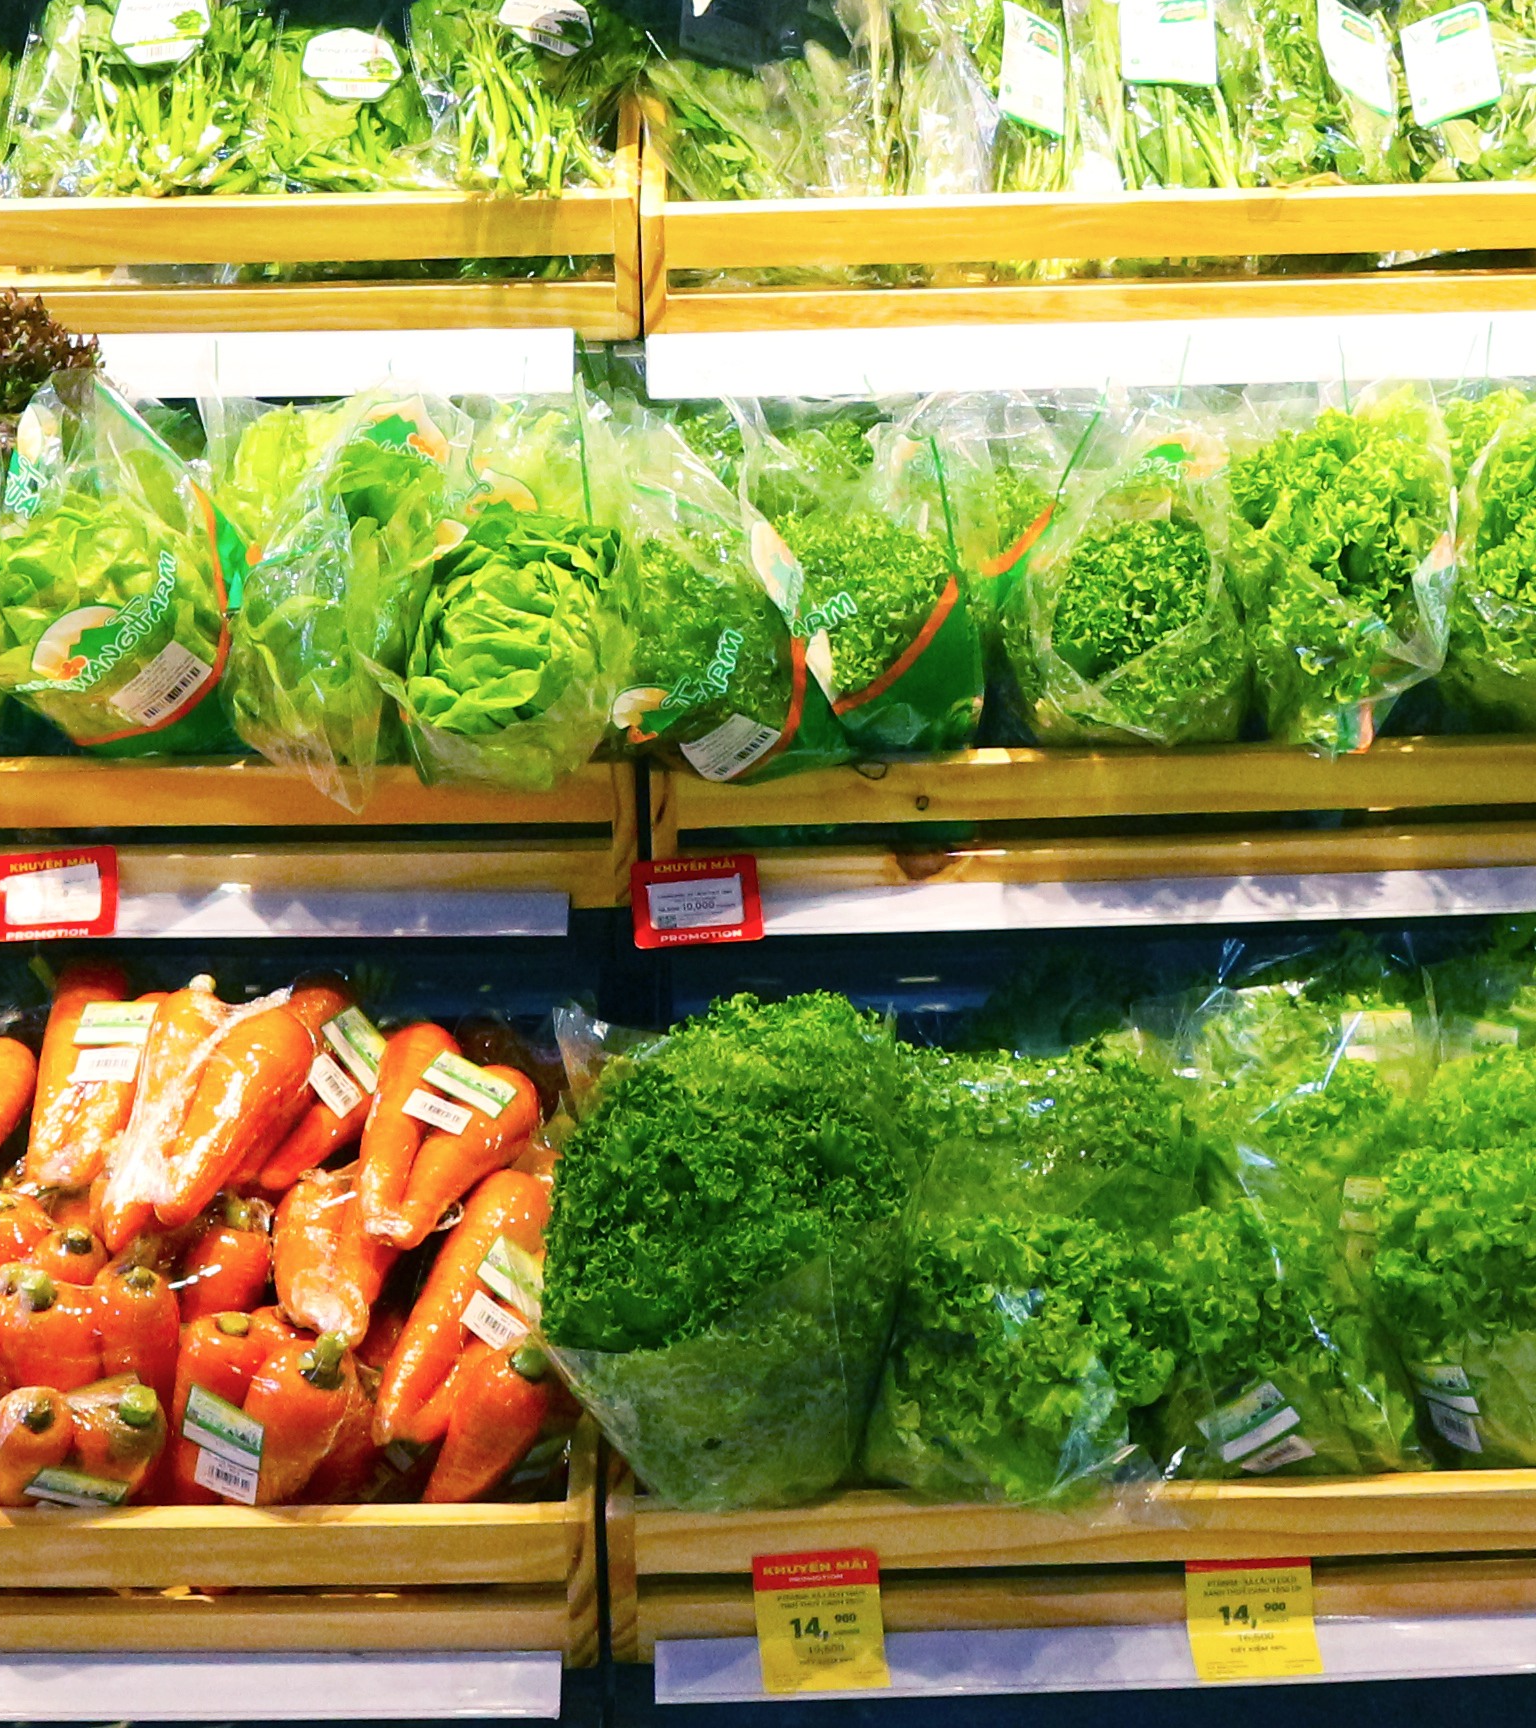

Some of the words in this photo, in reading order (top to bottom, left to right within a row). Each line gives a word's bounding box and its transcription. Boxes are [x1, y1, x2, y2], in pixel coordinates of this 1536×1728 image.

[791, 590, 858, 638] ARM
[9, 859, 64, 873] KHUYẾN
[653, 860, 708, 874] KHUYẾN
[710, 859, 736, 871] MÃI
[5, 927, 89, 941] PROMOTION
[660, 928, 743, 943] PROMOTION
[762, 1561, 832, 1576] KHUYẾN
[835, 1559, 869, 1571] MÃI
[1217, 1604, 1258, 1629] 14,
[1264, 1601, 1287, 1612] 900
[789, 1616, 831, 1642] 14,
[834, 1613, 857, 1624] 900
